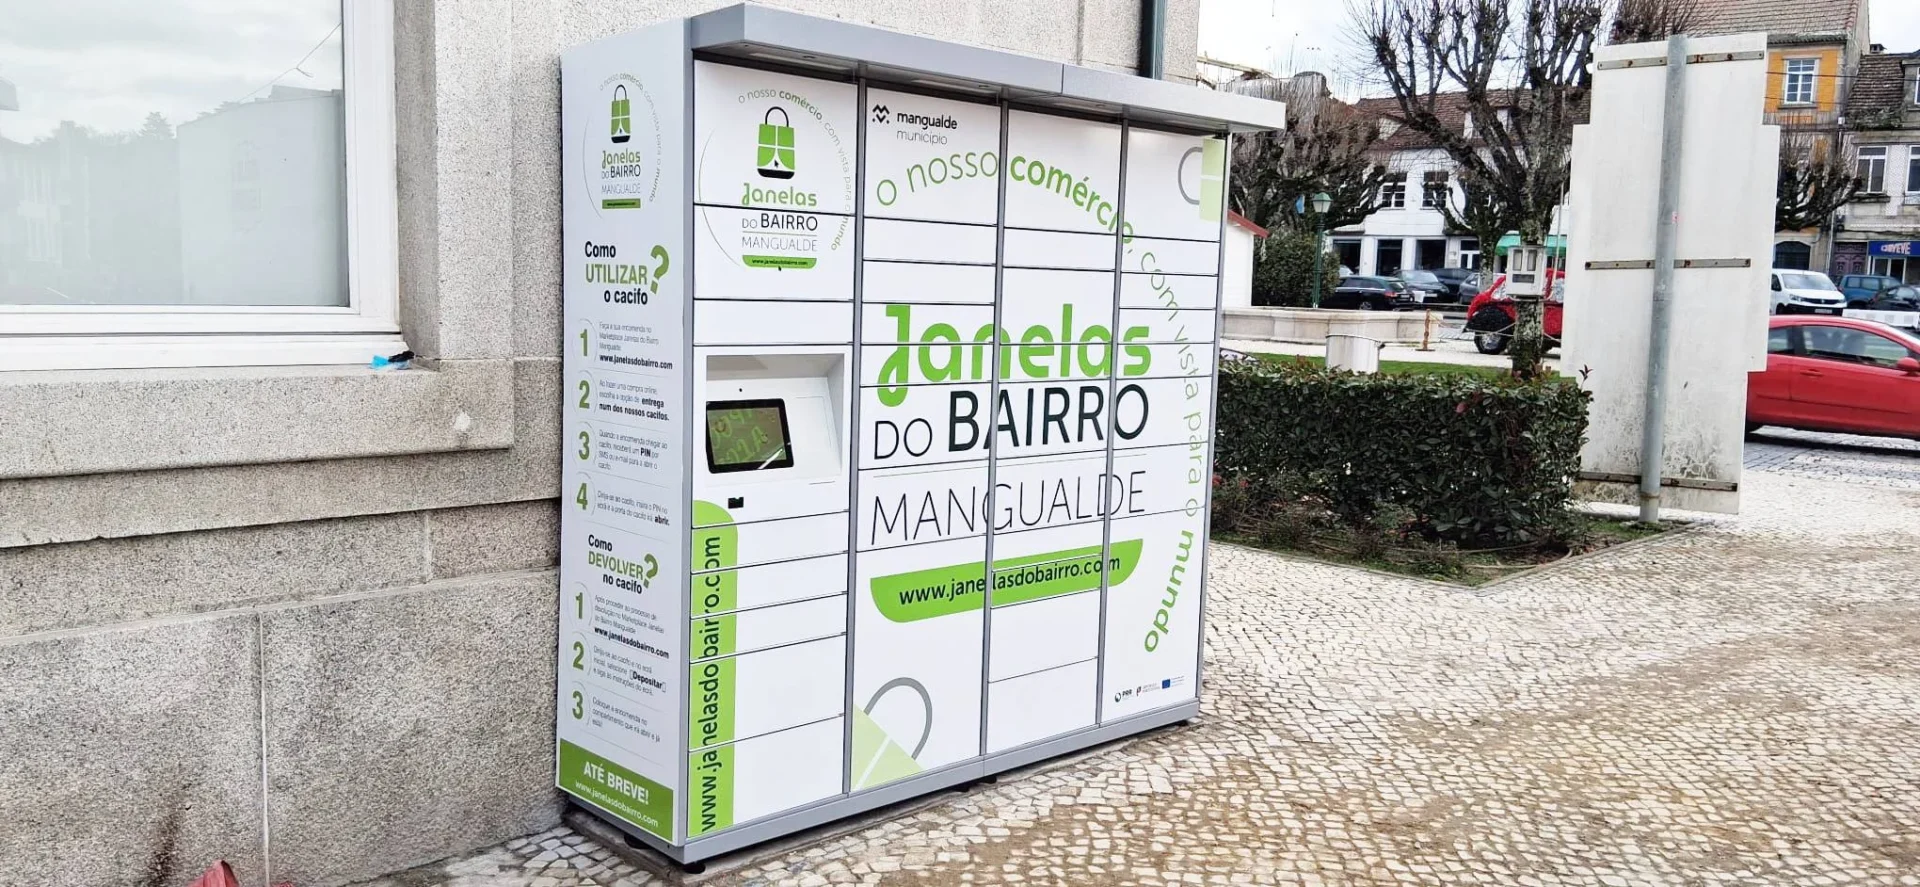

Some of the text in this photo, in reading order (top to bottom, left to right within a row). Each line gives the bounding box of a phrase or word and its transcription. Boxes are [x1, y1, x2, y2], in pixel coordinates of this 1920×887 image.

[738, 95, 746, 104] o
[747, 89, 777, 100] nosso
[824, 122, 841, 146] com
[897, 112, 958, 130] mangualde
[602, 147, 641, 169] Janelas
[610, 164, 641, 179] BAIRRO
[907, 151, 998, 193] nosso
[742, 183, 818, 207] Janelas
[844, 176, 852, 201] para
[877, 179, 897, 206] o
[742, 213, 818, 231] DO BAIRRO
[831, 213, 850, 251] mundo
[584, 241, 616, 258] Como
[742, 236, 818, 252] MANGUALDE
[585, 263, 648, 285] UTILIZAR
[1141, 252, 1179, 321] com
[603, 288, 648, 305] o cacifo
[579, 329, 588, 357] 1
[876, 303, 1151, 407] Janelas
[1174, 325, 1199, 400] vista
[579, 380, 590, 409] 2
[642, 397, 665, 409] entrega
[599, 403, 612, 412] num
[613, 404, 623, 413] dos
[625, 407, 645, 417] nossos
[874, 384, 1149, 460] DO BAIRRO
[578, 431, 590, 460] 3
[641, 447, 651, 457] PIN
[1183, 412, 1202, 485] para
[576, 482, 588, 511] 4
[871, 470, 1146, 546] MANGUALDE
[1185, 498, 1198, 517] o
[588, 534, 613, 552] Como
[588, 551, 644, 580] DEVOLVER
[603, 574, 643, 595] no cacifo
[899, 557, 1120, 605] www.janelasdobairro.com
[1144, 530, 1195, 653] mundo
[575, 592, 583, 619] 1
[572, 641, 584, 671] 2
[697, 536, 723, 832] www.janelasdobairro.com
[572, 690, 584, 720] 3
[583, 761, 649, 806] ATÉ BREVE!
[575, 780, 659, 827] www.janelasdobairro.com
